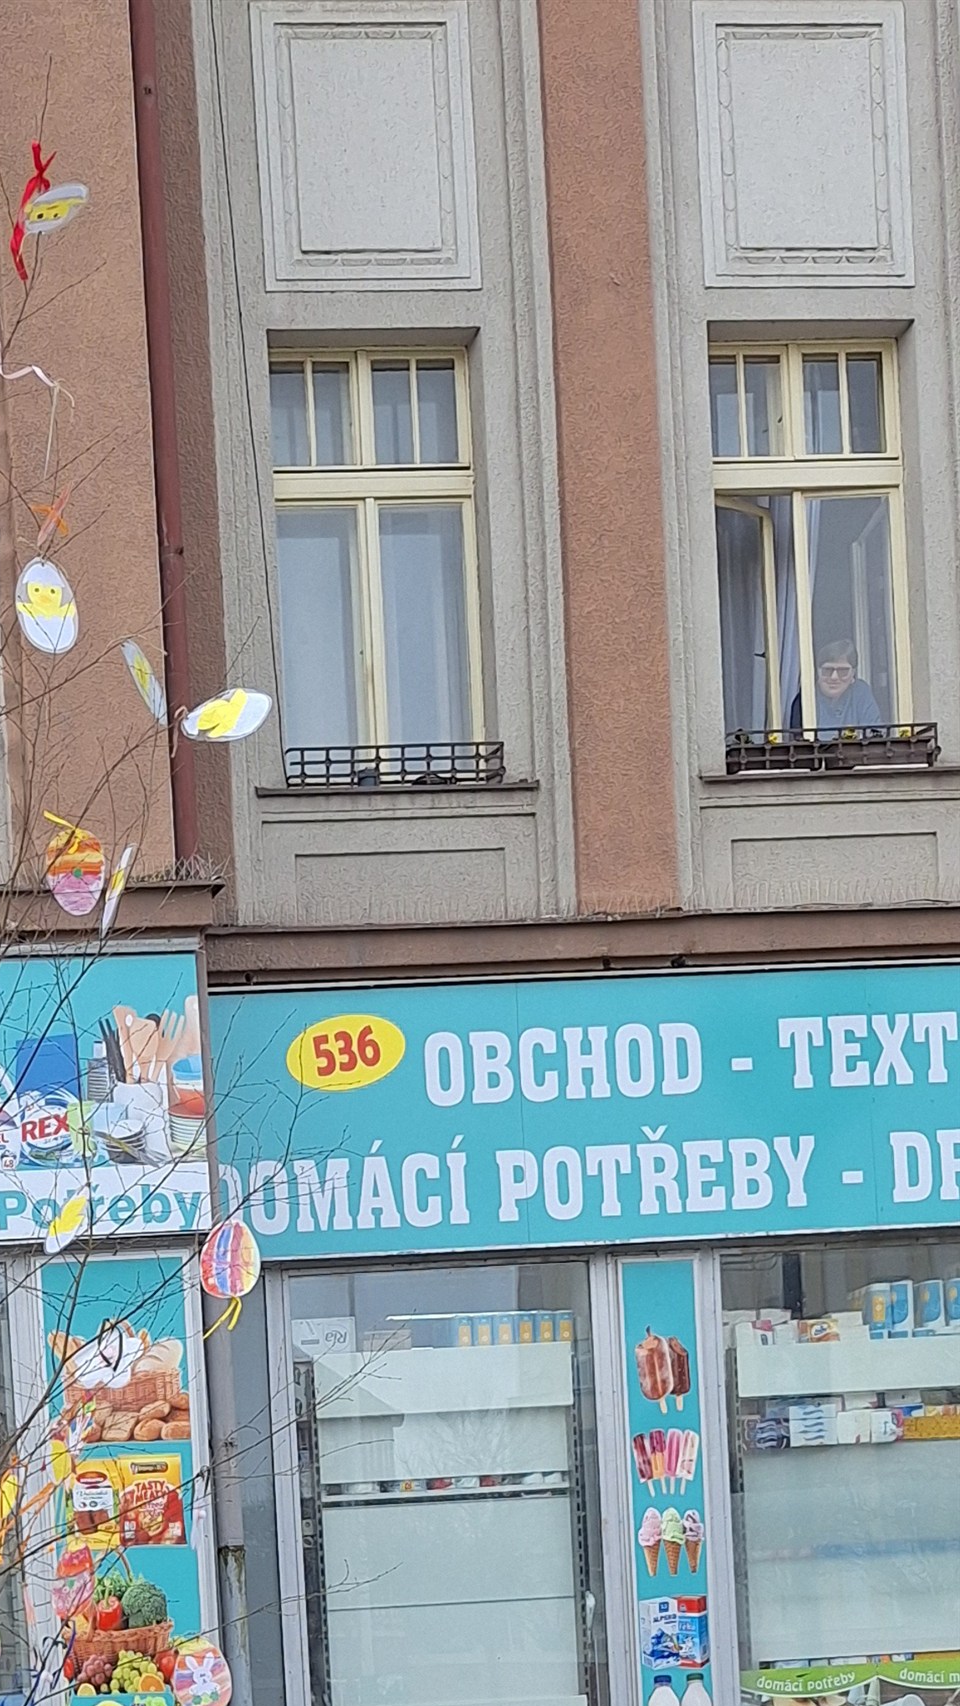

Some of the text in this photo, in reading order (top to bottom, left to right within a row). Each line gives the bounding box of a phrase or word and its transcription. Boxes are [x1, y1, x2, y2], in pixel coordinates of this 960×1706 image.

[312, 1025, 381, 1077] 536
[424, 1011, 958, 1107] OBCHOD - TEXT
[21, 1113, 70, 1142] REX
[496, 1125, 815, 1222] POTŘEBY
[842, 1171, 863, 1184] -
[756, 1671, 855, 1692] domácí potřeby
[899, 1668, 944, 1683] domácí
